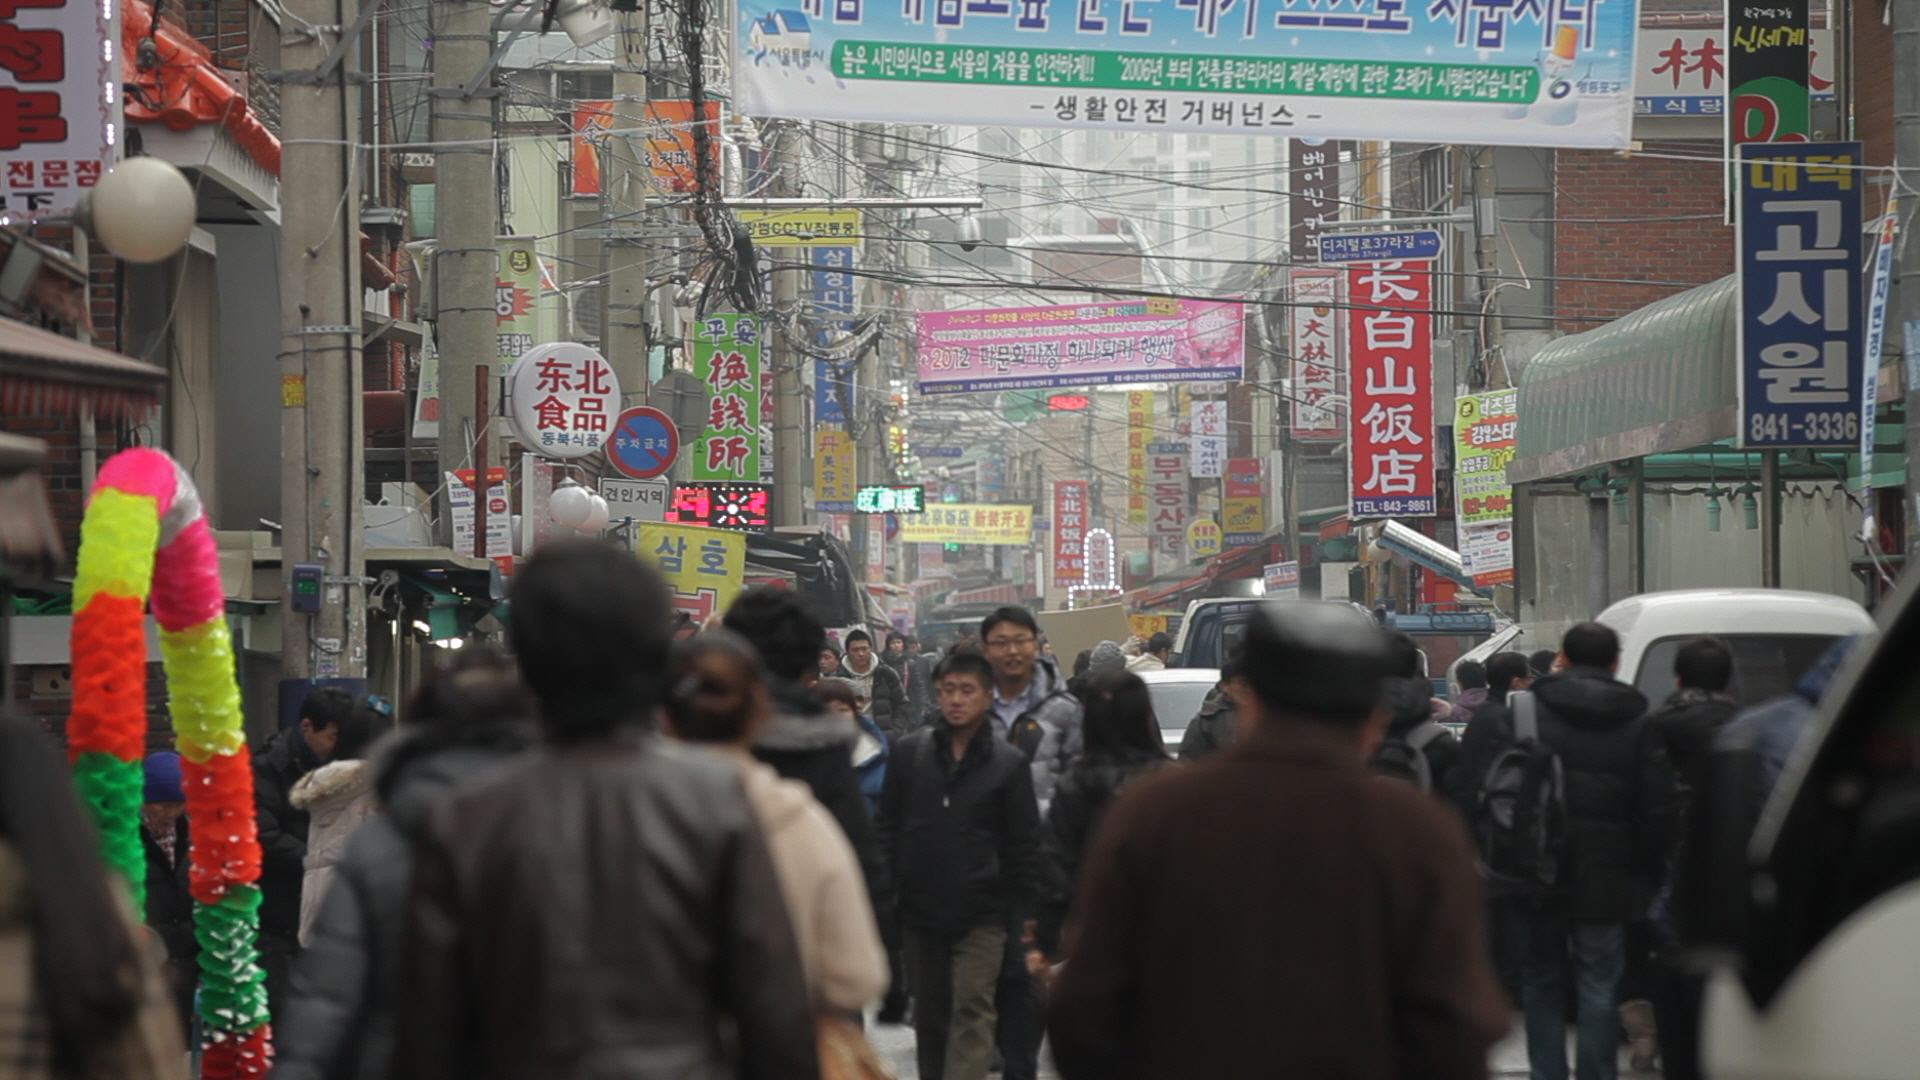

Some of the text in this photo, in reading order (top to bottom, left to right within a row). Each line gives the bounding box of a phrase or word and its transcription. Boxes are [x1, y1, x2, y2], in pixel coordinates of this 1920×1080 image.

[1733, 25, 1805, 53] 신세계
[842, 45, 868, 74] 높은
[871, 45, 947, 77] 시민의식으로
[950, 49, 989, 79] 서울의
[992, 51, 1031, 81] 겨울을
[1166, 58, 1193, 86] 부터
[1196, 59, 1286, 89] 건축물관리자의
[1361, 65, 1390, 94] 관한
[1392, 66, 1433, 95] 조례가
[1751, 155, 1852, 191] 대덕
[1323, 235, 1415, 252] 디지털로37라길
[1755, 200, 1849, 404] 고시원
[701, 319, 757, 346] 平安
[931, 346, 969, 369] 2012
[1140, 335, 1175, 367] 행사
[535, 358, 611, 394] 东北
[1357, 261, 1424, 494] 长白山饭店
[532, 395, 608, 432] 食品
[1751, 411, 1858, 442] 841-3336
[541, 432, 599, 447] 동북식품
[616, 438, 667, 449] 주차금지
[605, 487, 663, 503] 견인지역
[1153, 457, 1185, 533] 부동산
[1355, 500, 1431, 514] TEL:843-9861
[655, 535, 728, 576] 삼호
